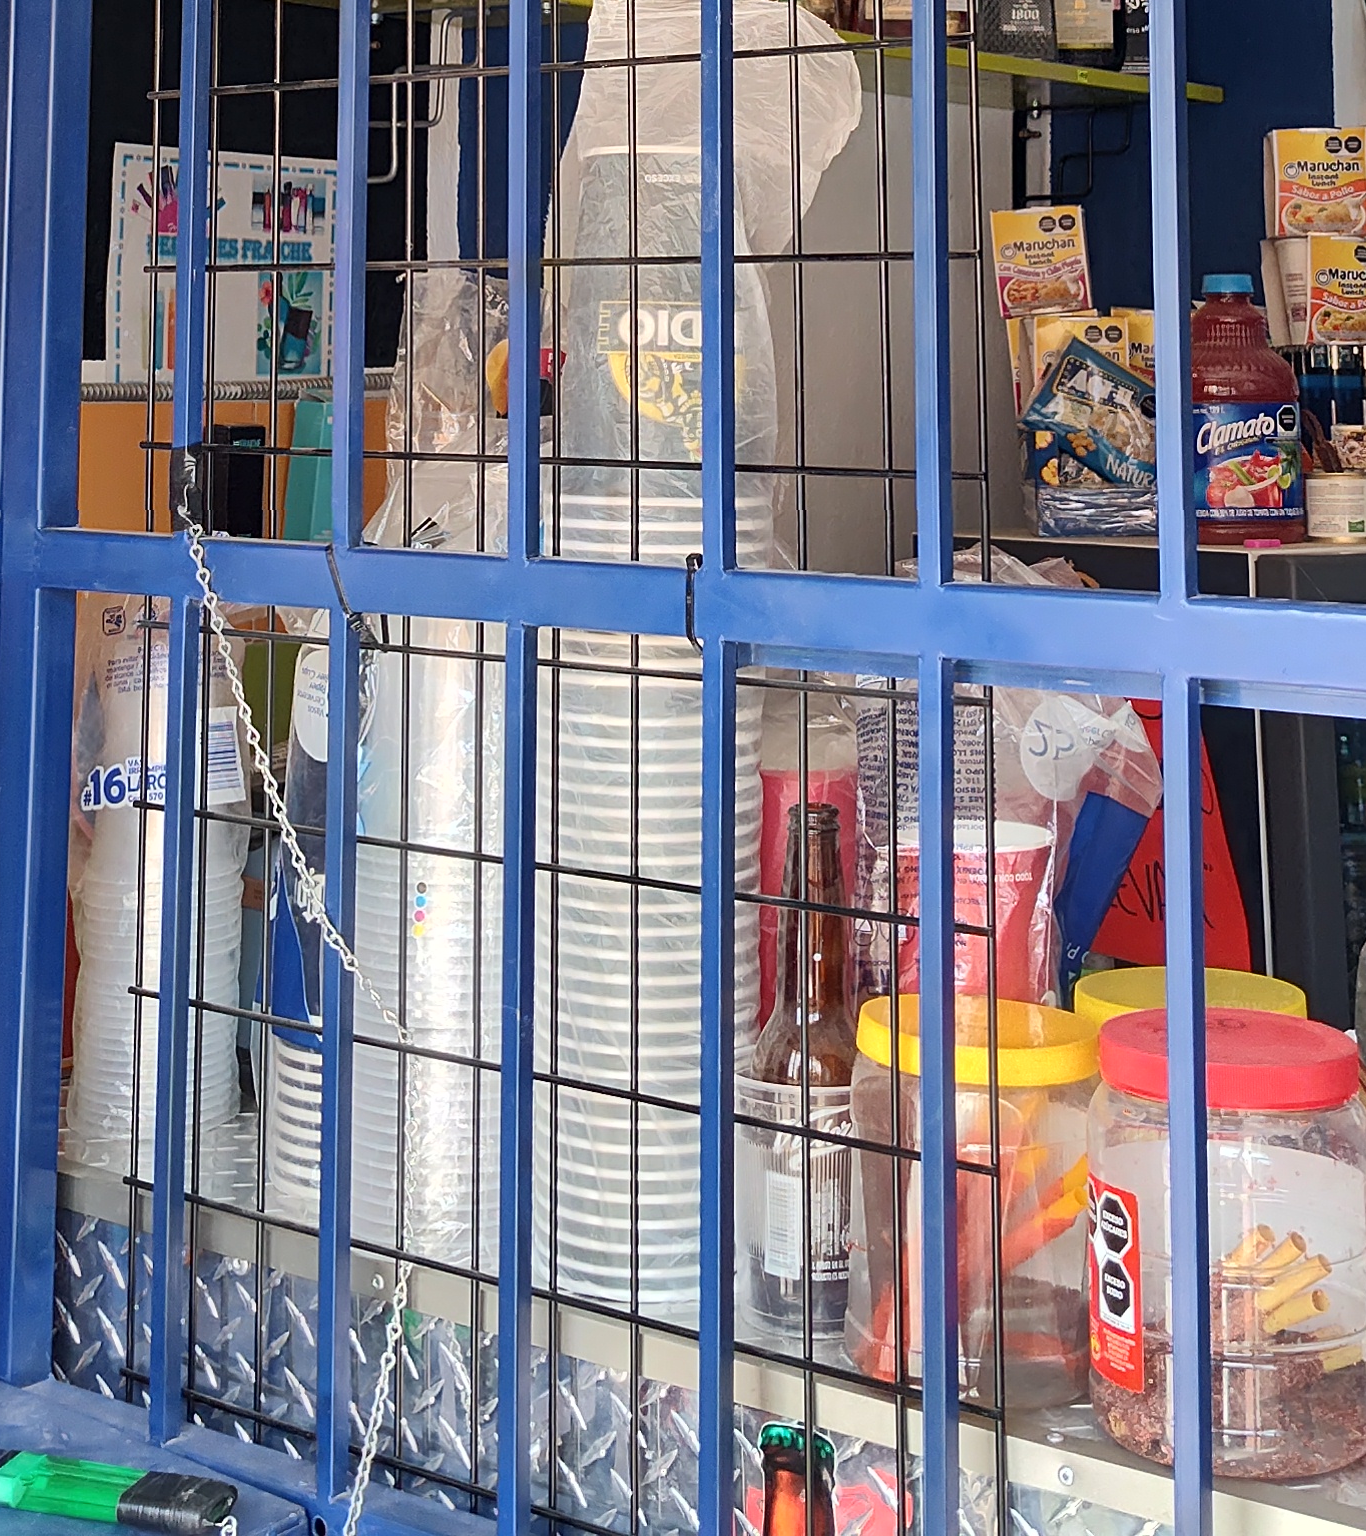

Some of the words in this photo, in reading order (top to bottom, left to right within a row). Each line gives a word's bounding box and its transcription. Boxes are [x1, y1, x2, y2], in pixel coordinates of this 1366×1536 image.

[1011, 8, 1040, 21] 1800
[1297, 159, 1360, 172] Maruchan
[1307, 173, 1340, 181] Instant
[1291, 184, 1319, 200] Sabor
[1322, 192, 1328, 200] a
[1329, 185, 1355, 199] Pollo
[1013, 237, 1076, 252] Maruchan
[1337, 281, 1366, 289] Instant
[1341, 287, 1365, 296] Lunch
[1322, 291, 1348, 307] Sabor
[1349, 301, 1356, 309] a
[1197, 412, 1275, 455] Clamato
[83, 766, 126, 806] #16
[1102, 1209, 1125, 1226] EXCESO
[1104, 1272, 1126, 1290] EXCESO
